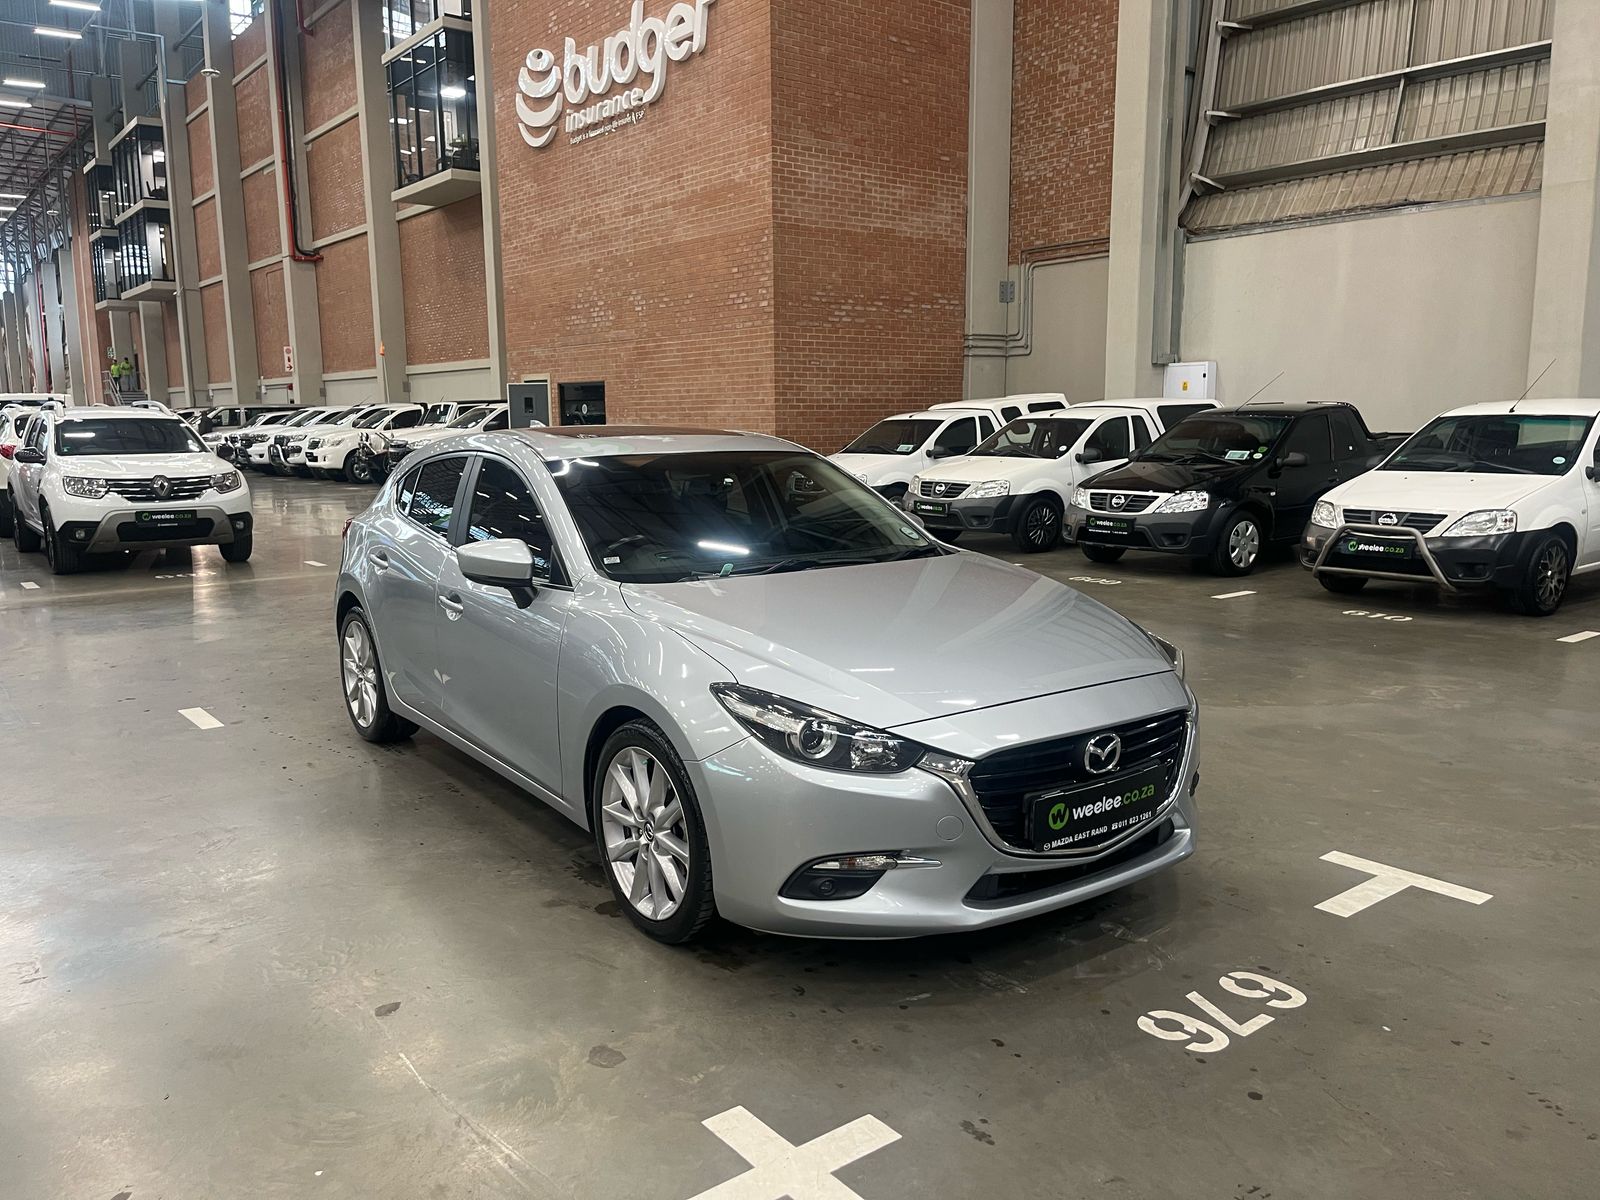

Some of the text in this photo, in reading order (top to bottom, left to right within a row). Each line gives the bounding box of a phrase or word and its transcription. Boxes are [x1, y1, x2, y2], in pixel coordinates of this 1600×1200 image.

[565, 87, 644, 133] insurance
[1342, 609, 1413, 622] 610
[1072, 784, 1155, 820] weelee.co.za
[1051, 835, 1074, 848] MAZDA
[1074, 830, 1091, 842] EAST
[1091, 825, 1108, 837] RAND
[1129, 815, 1139, 825] 823
[1139, 810, 1152, 821] 1261
